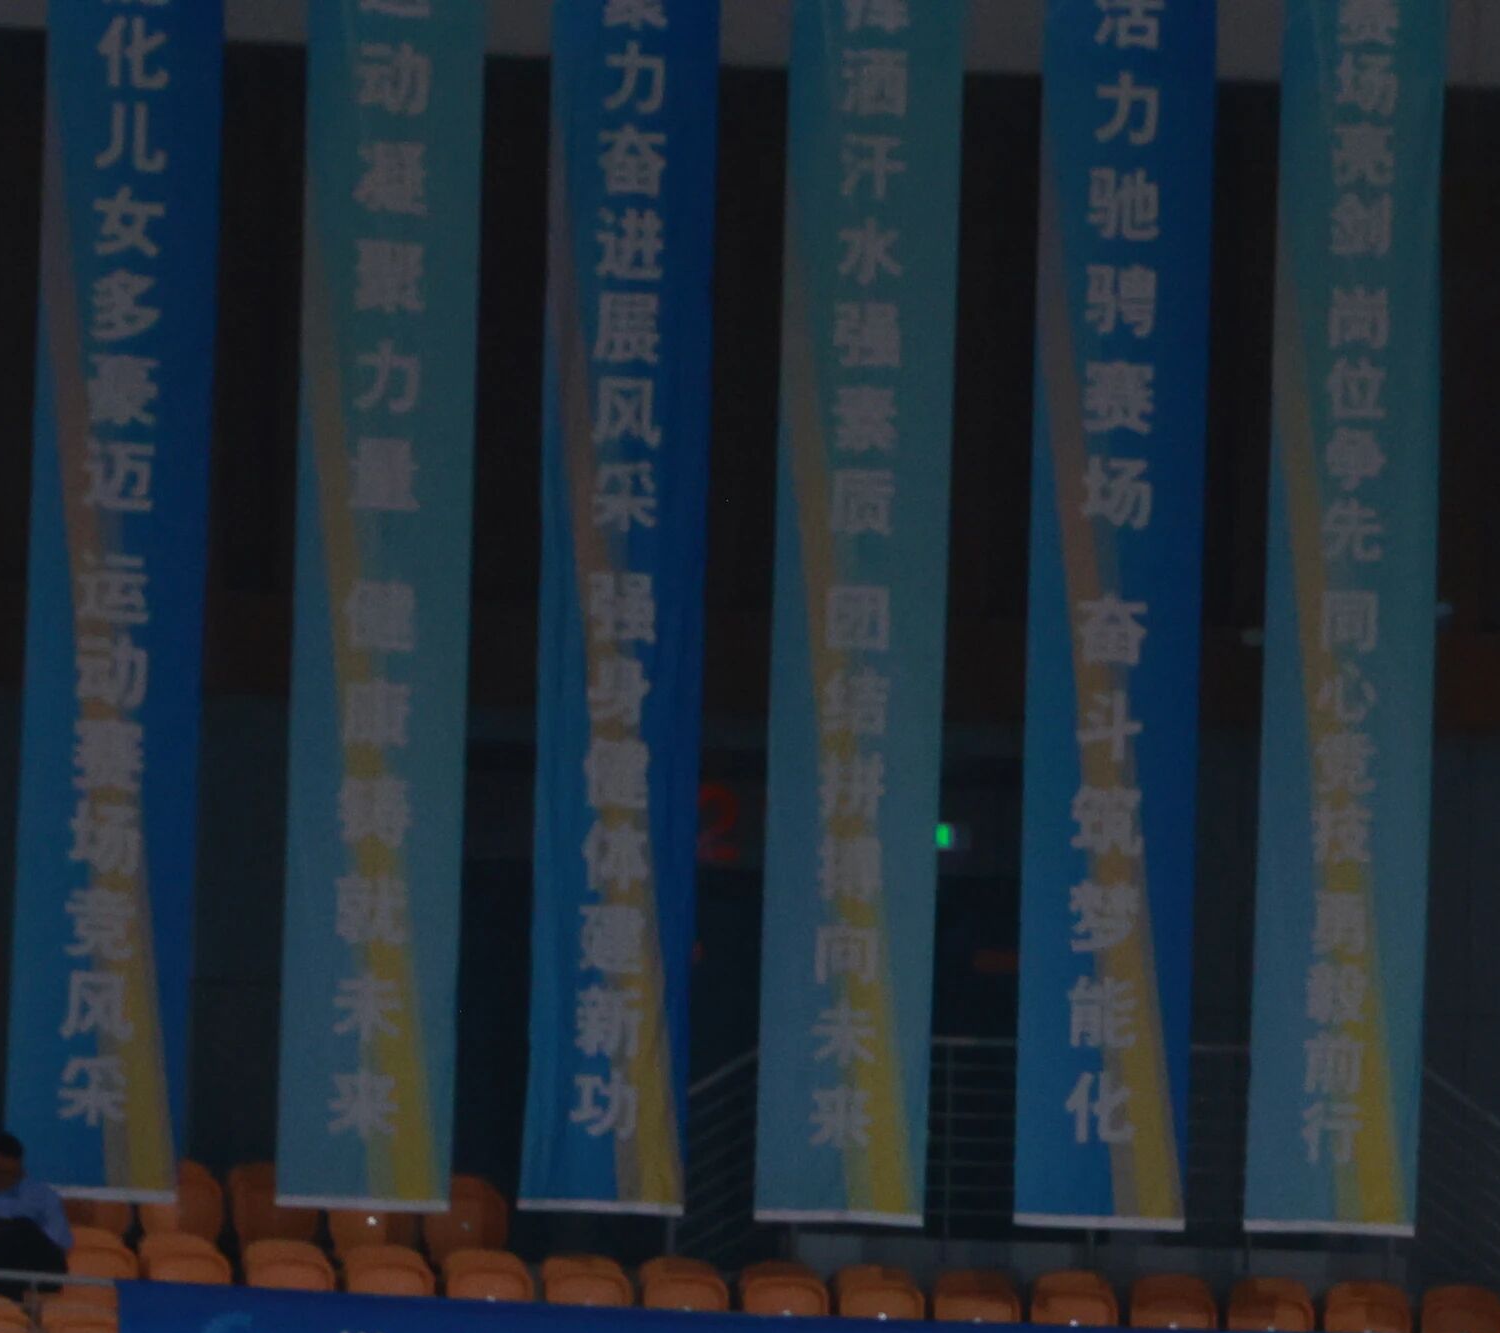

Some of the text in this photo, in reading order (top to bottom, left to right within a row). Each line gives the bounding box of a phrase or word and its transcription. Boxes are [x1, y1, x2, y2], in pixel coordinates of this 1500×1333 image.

[82, 0, 171, 513] 化儿女多豪迈
[346, 0, 433, 513] 动凝聚力量
